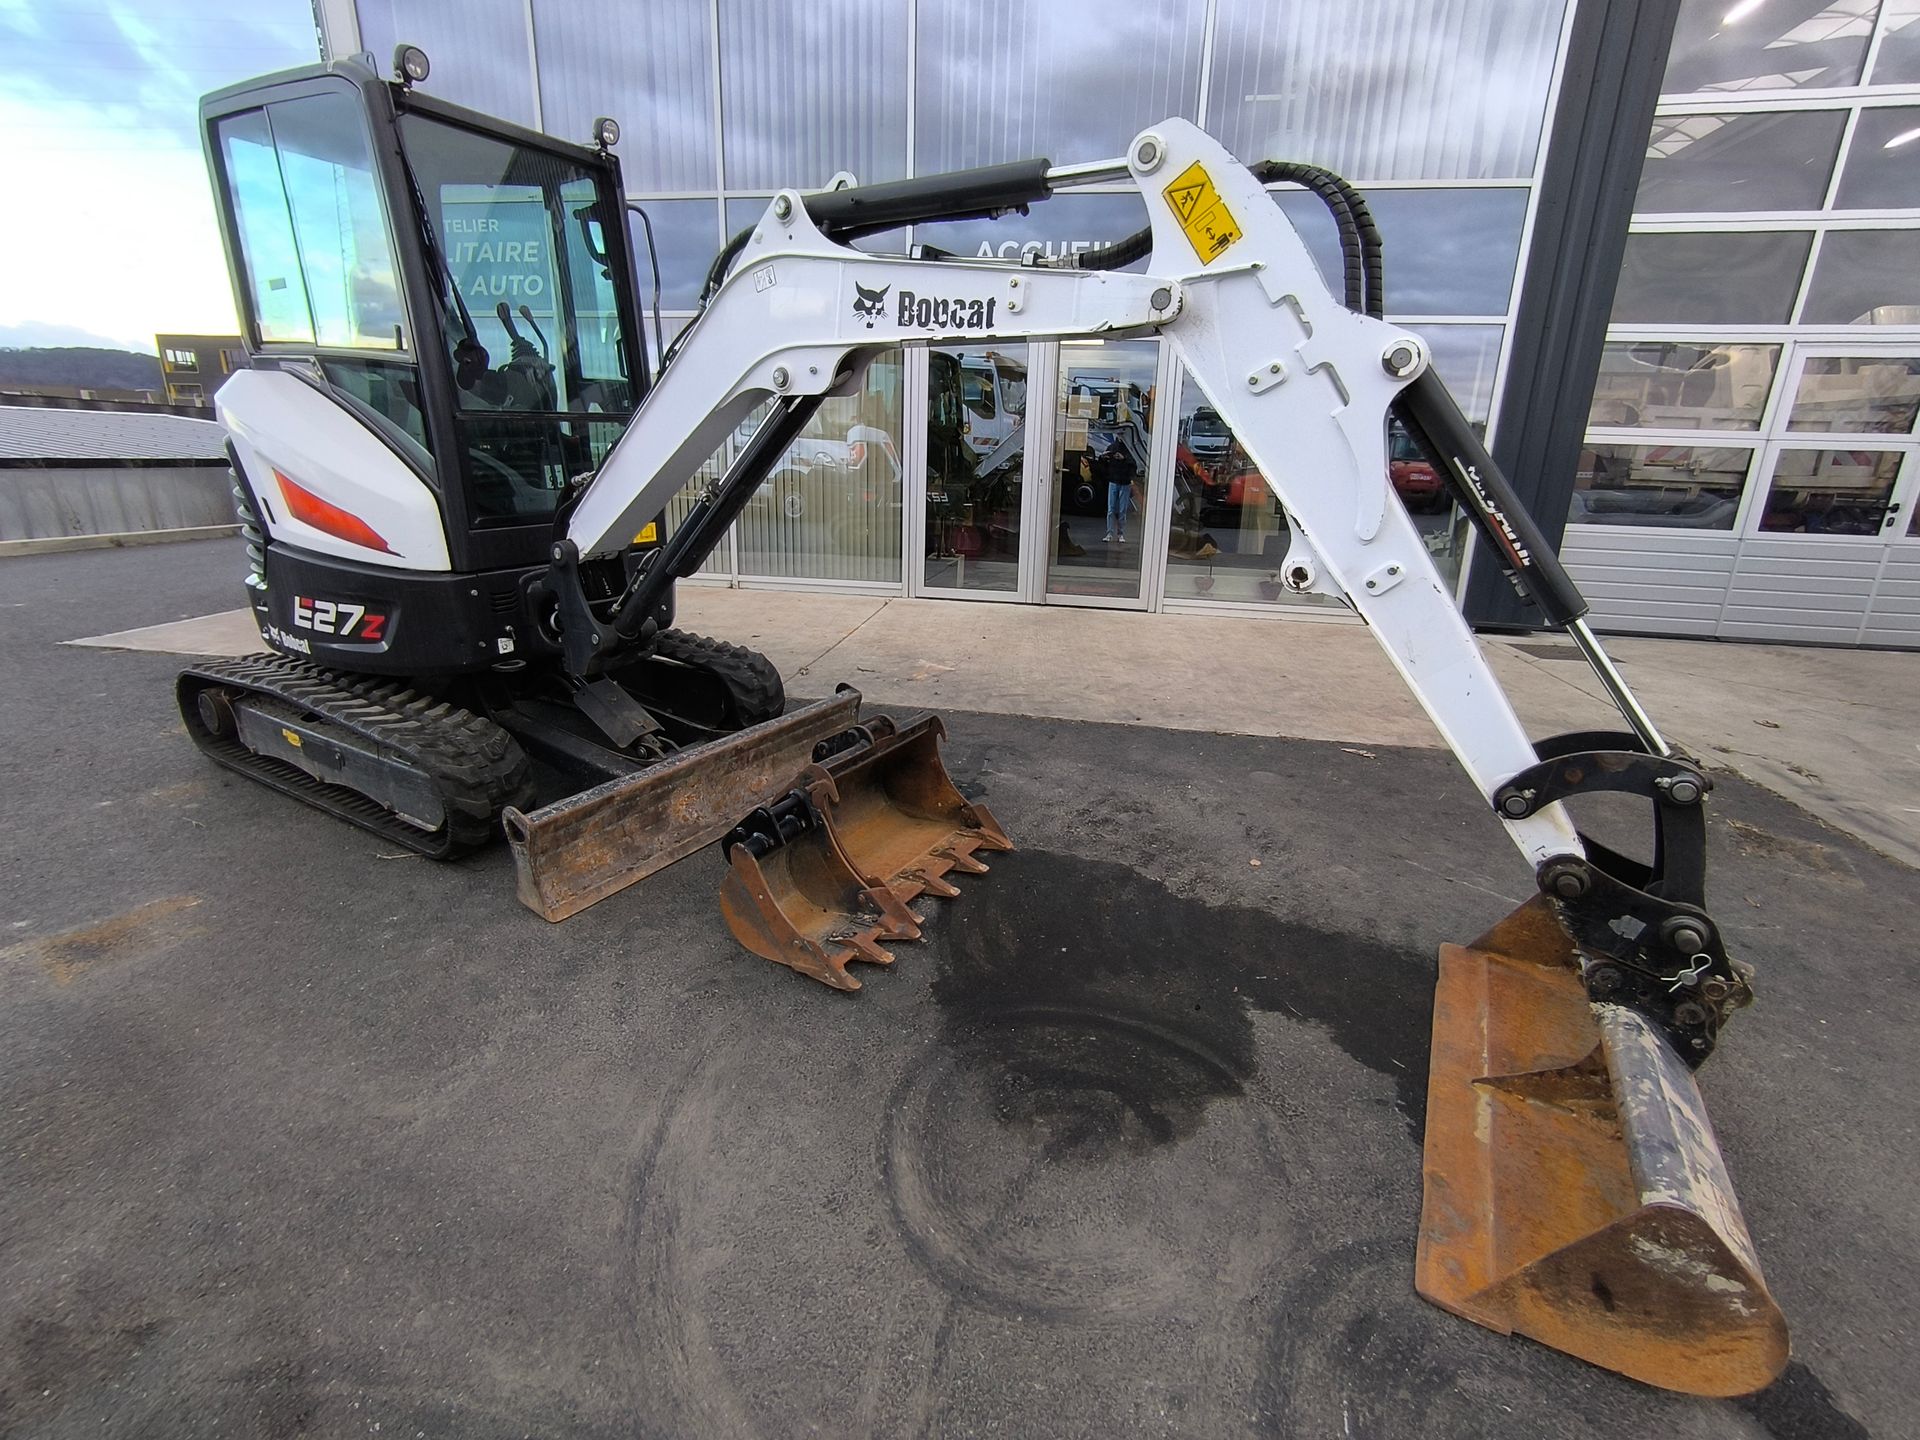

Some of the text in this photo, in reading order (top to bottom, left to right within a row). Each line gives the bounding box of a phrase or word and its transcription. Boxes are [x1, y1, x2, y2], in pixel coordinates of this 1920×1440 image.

[976, 240, 1112, 258] ACCUE
[470, 274, 544, 296] AUTO
[898, 290, 997, 330] Bobcat
